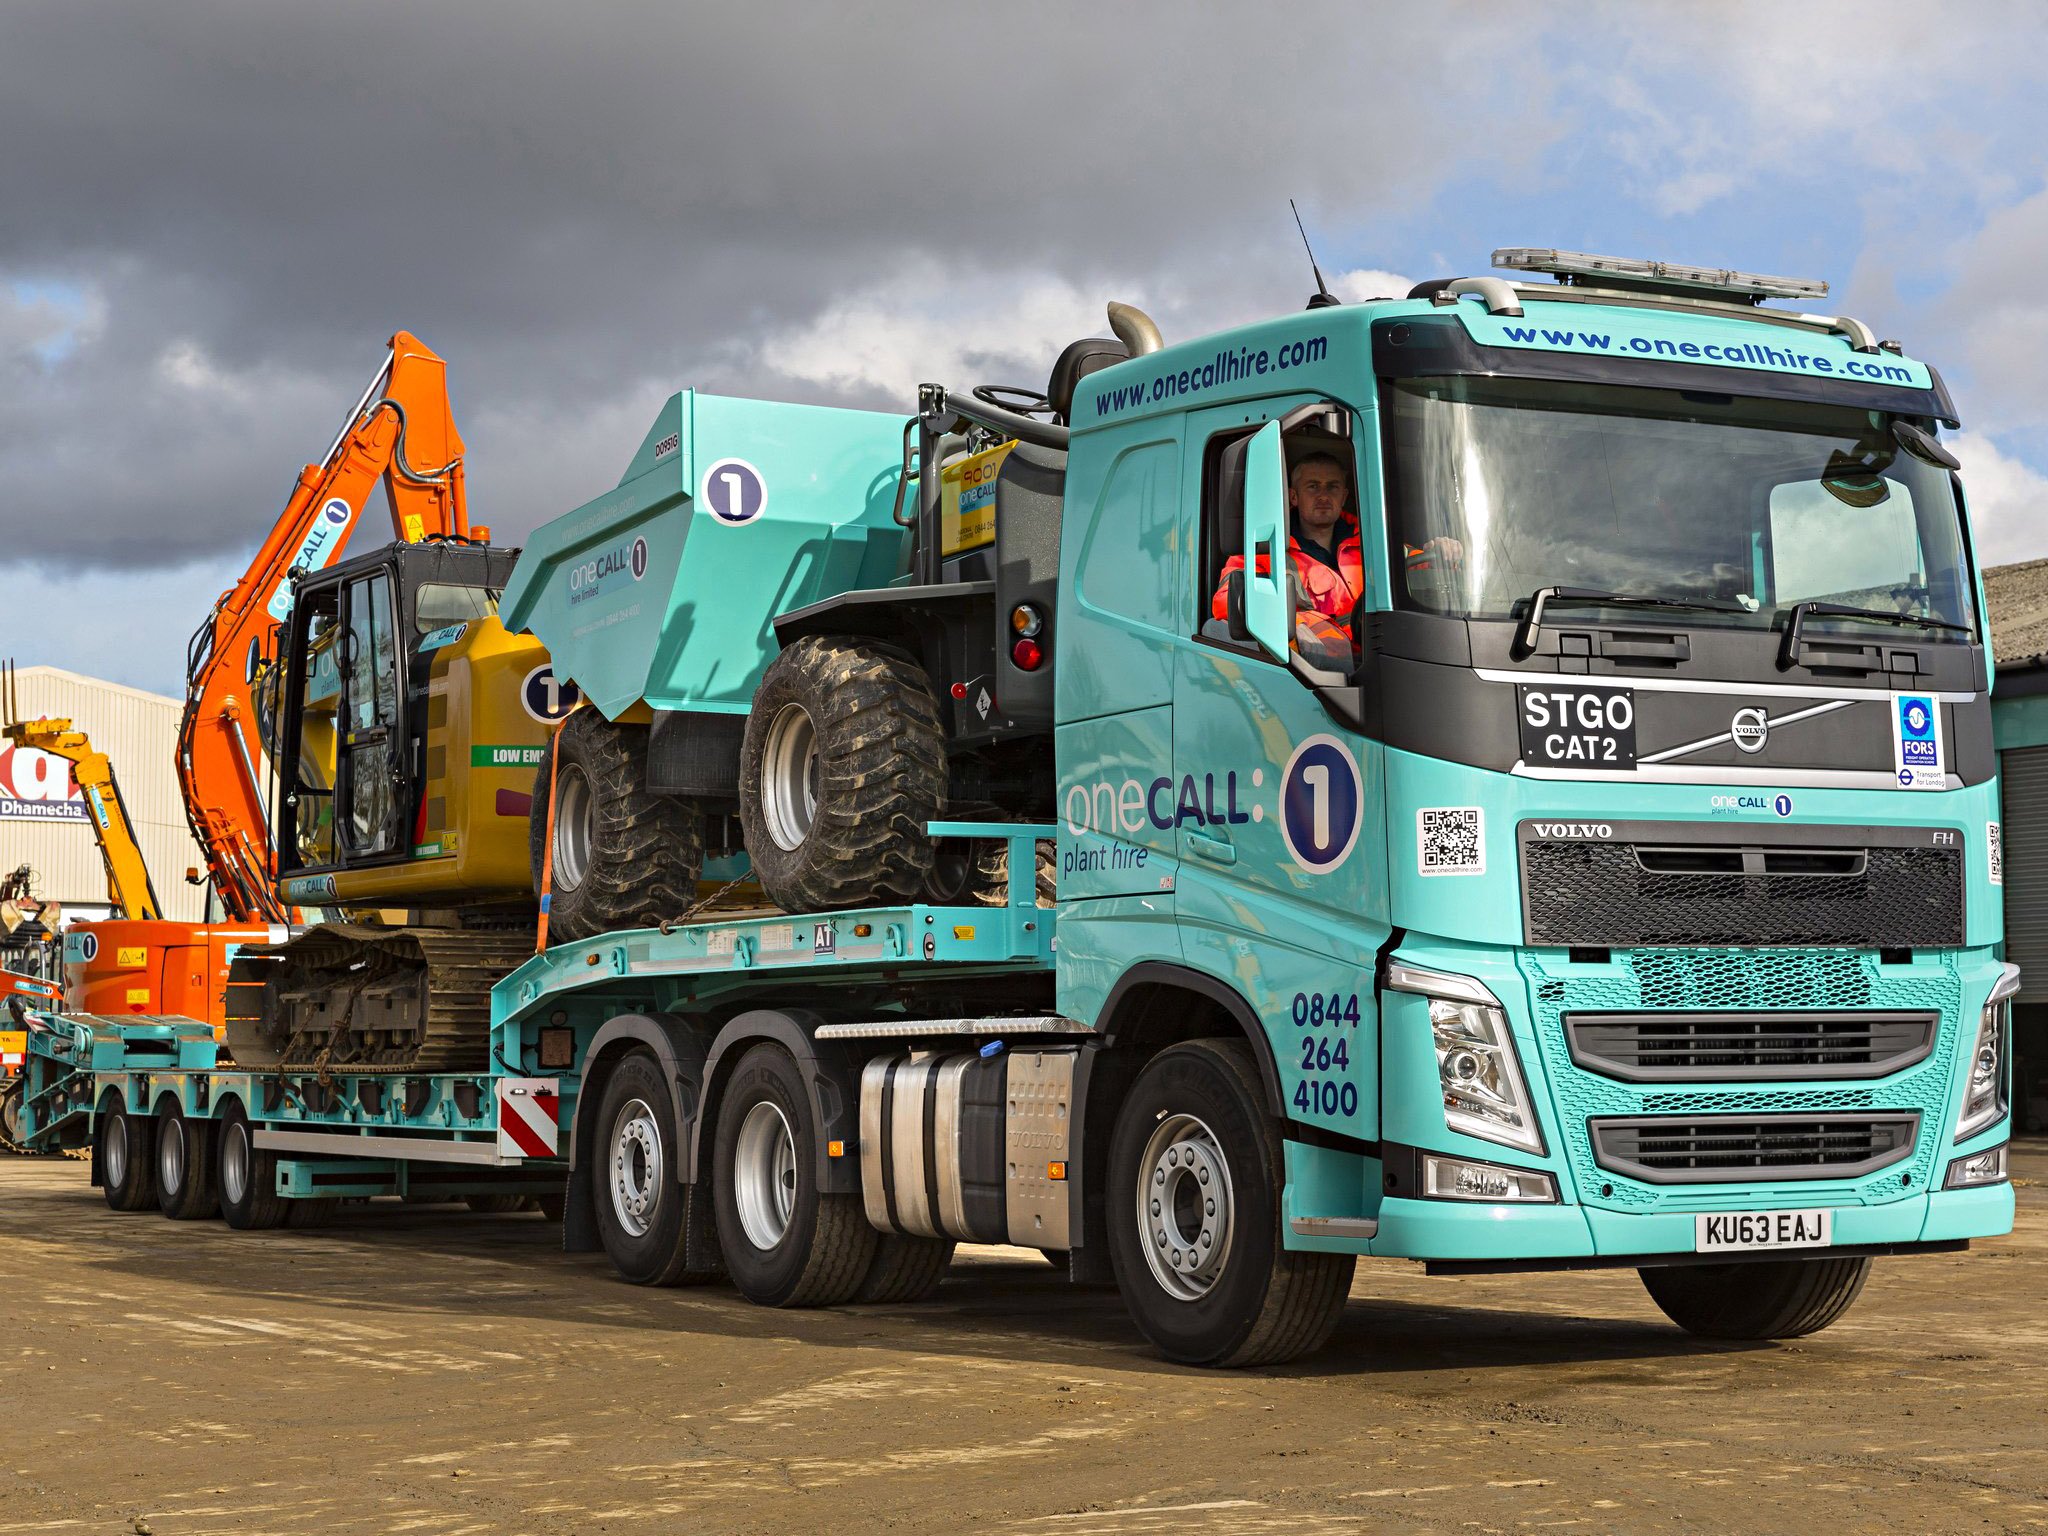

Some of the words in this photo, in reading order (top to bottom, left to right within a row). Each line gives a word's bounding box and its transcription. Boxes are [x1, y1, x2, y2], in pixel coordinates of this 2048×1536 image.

[1503, 326, 1913, 383] www.onecallhire.com
[1096, 336, 1328, 416] www.onecallhire.com
[1525, 692, 1634, 730] STGO
[1734, 727, 1767, 735] VOLVO
[493, 749, 520, 763] LOW
[1904, 741, 1934, 755] FORS
[1916, 771, 1942, 779] Transport
[2, 801, 82, 817] Dhamecha
[1532, 823, 1613, 839] VOLVO
[1932, 832, 1954, 845] FH
[1064, 843, 1106, 880] plant
[1112, 840, 1149, 870] hire
[1292, 992, 1361, 1028] 0844
[1301, 1036, 1350, 1072] 264
[1293, 1079, 1358, 1117] 4100
[1008, 1130, 1064, 1150] VOLVO
[1706, 1215, 1770, 1245] KU63
[1777, 1213, 1822, 1243] EAJ
